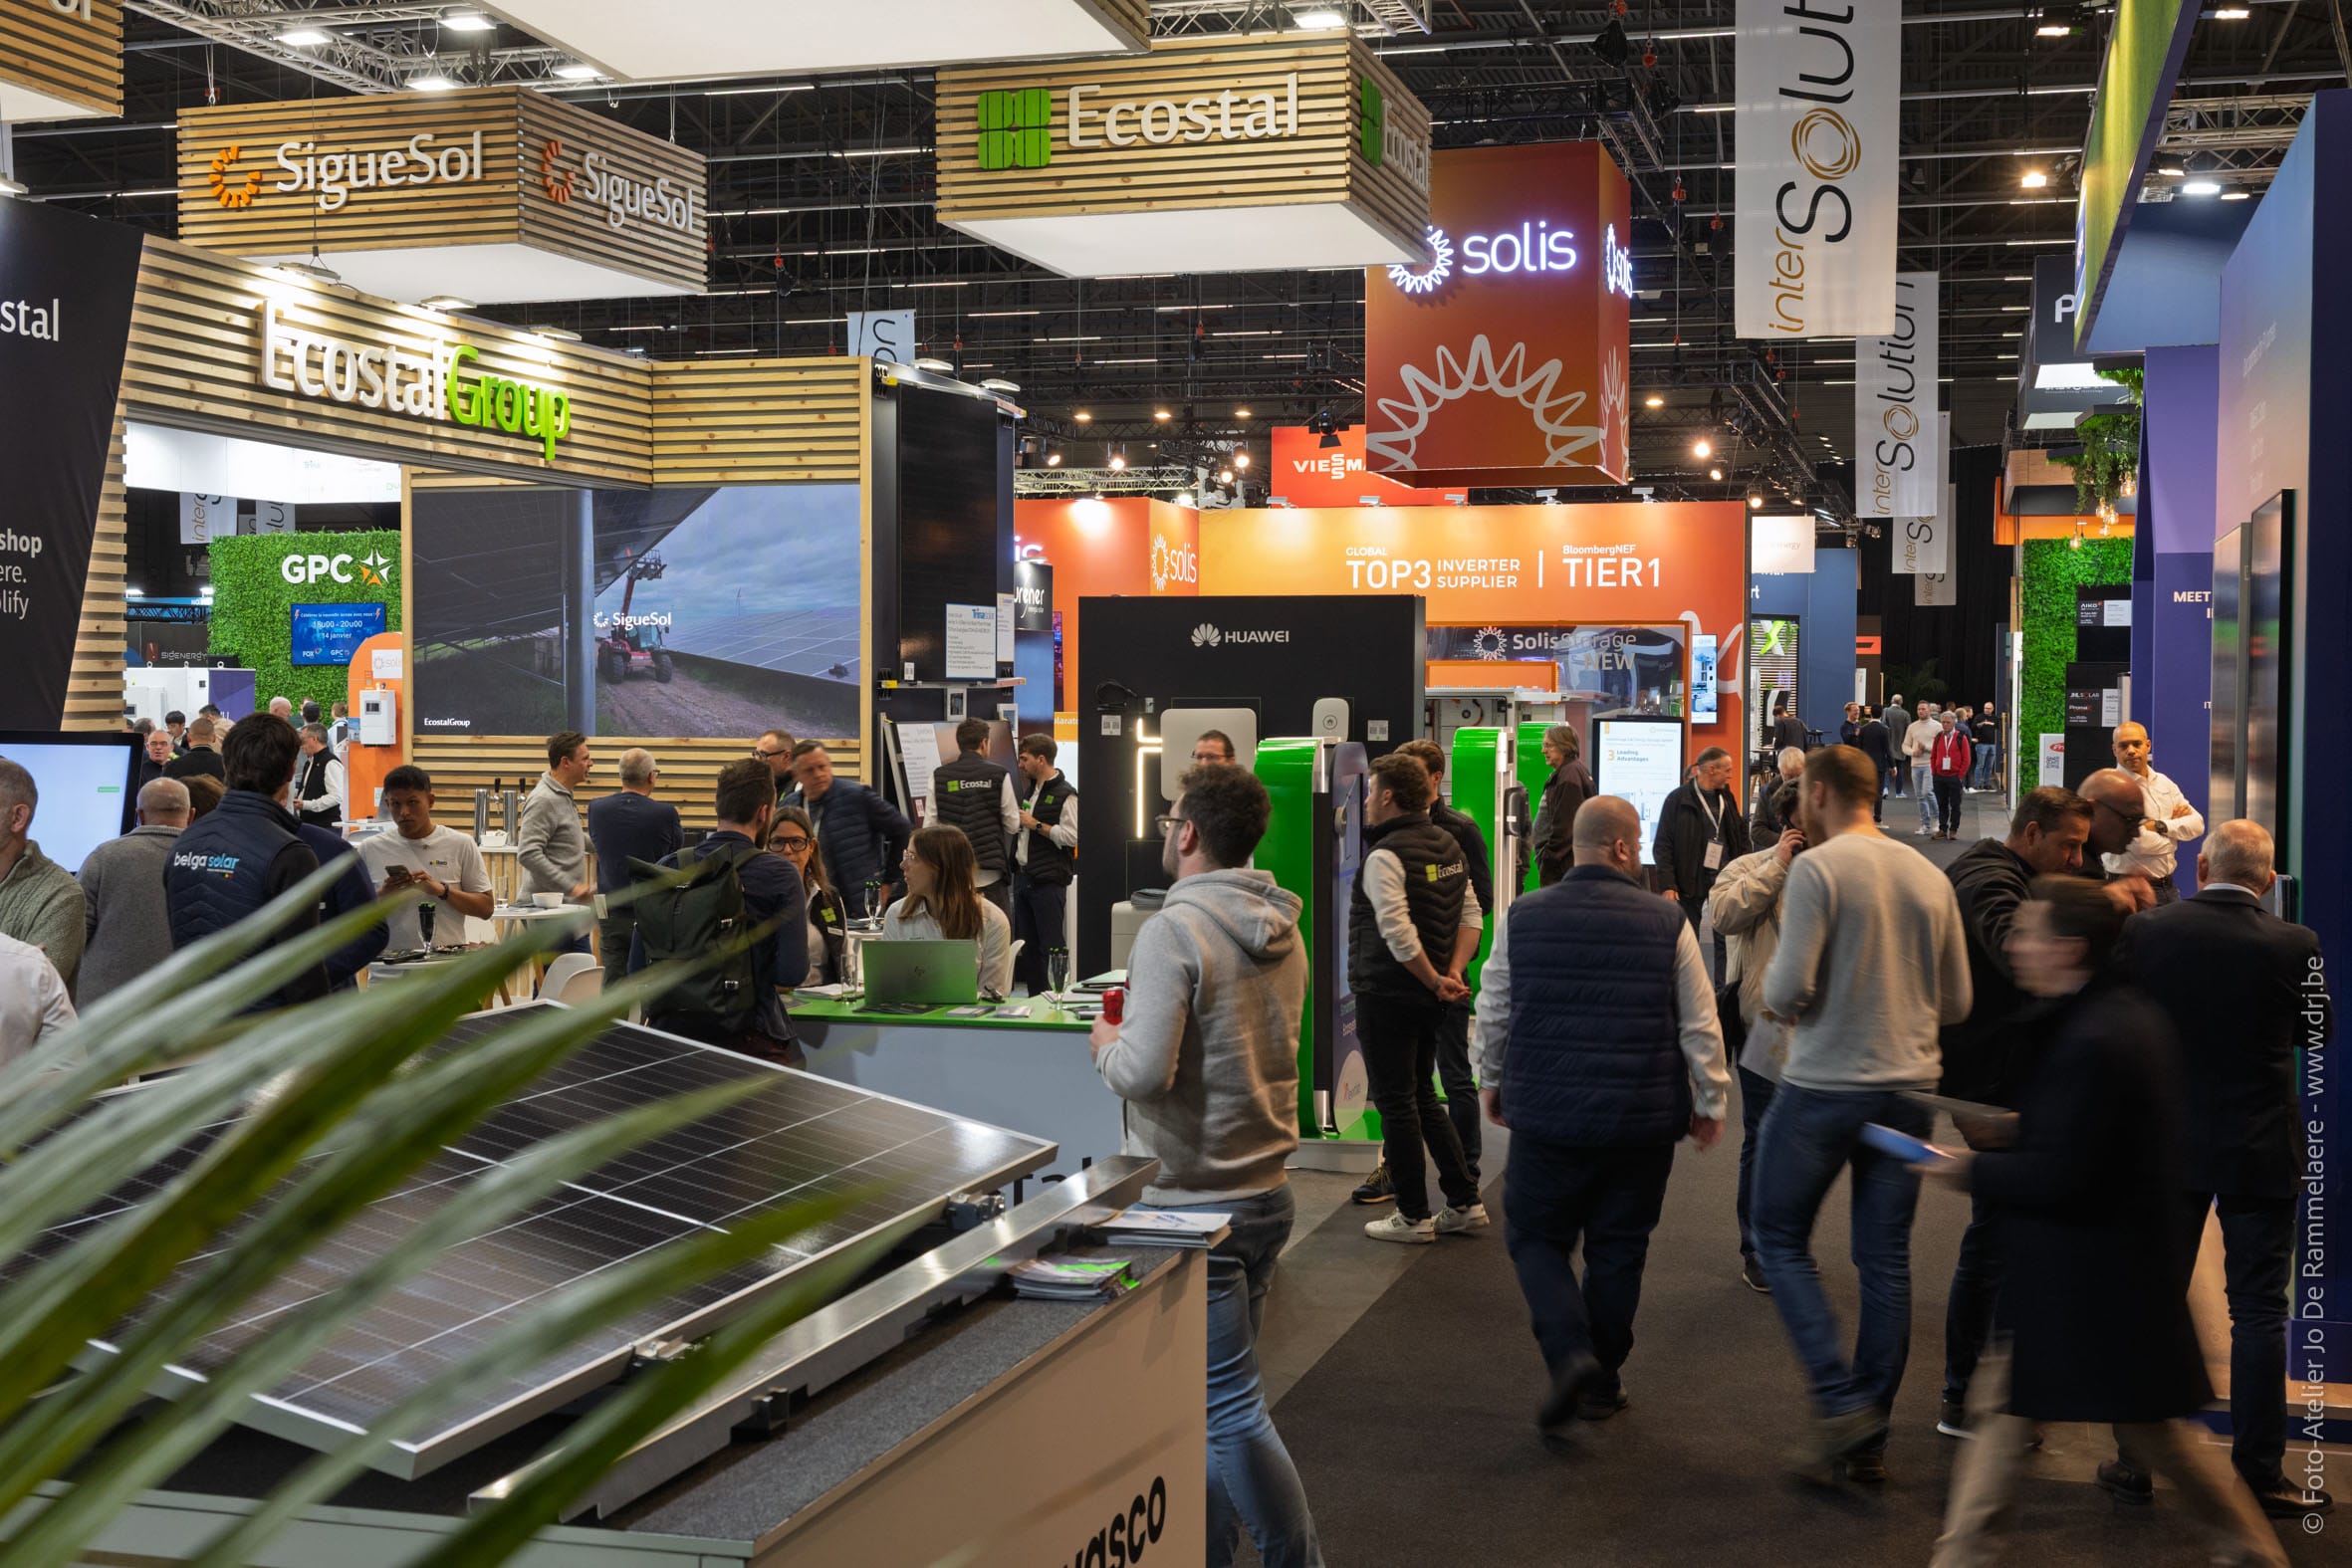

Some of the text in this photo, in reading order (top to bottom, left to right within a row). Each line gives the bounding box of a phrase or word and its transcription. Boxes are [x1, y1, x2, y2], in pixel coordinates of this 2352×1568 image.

[1068, 73, 1298, 148] Ecostal
[1382, 99, 1429, 195] Ecostal
[276, 130, 484, 211] SigueSol
[583, 152, 695, 232] SigueSol
[1462, 222, 1577, 274] solis
[261, 299, 571, 462] EcostalGroup
[1293, 453, 1367, 480] VIESSM
[1345, 547, 1388, 557] GLOBAL
[1562, 544, 1636, 557] BloombergNEF
[281, 554, 353, 584] GPC
[1170, 542, 1197, 584] solis
[1437, 559, 1521, 572] INVERTER
[1346, 560, 1432, 589] TOP3
[1437, 574, 1518, 588] SUPPLIER
[2173, 591, 2212, 603] MEET
[612, 612, 672, 631] SigueSol
[1225, 630, 1290, 643] HUAWEI
[1583, 652, 1636, 670] NEW
[424, 717, 471, 728] EcostalGroup
[959, 780, 992, 790] Ecostal
[173, 852, 240, 870] belga solar
